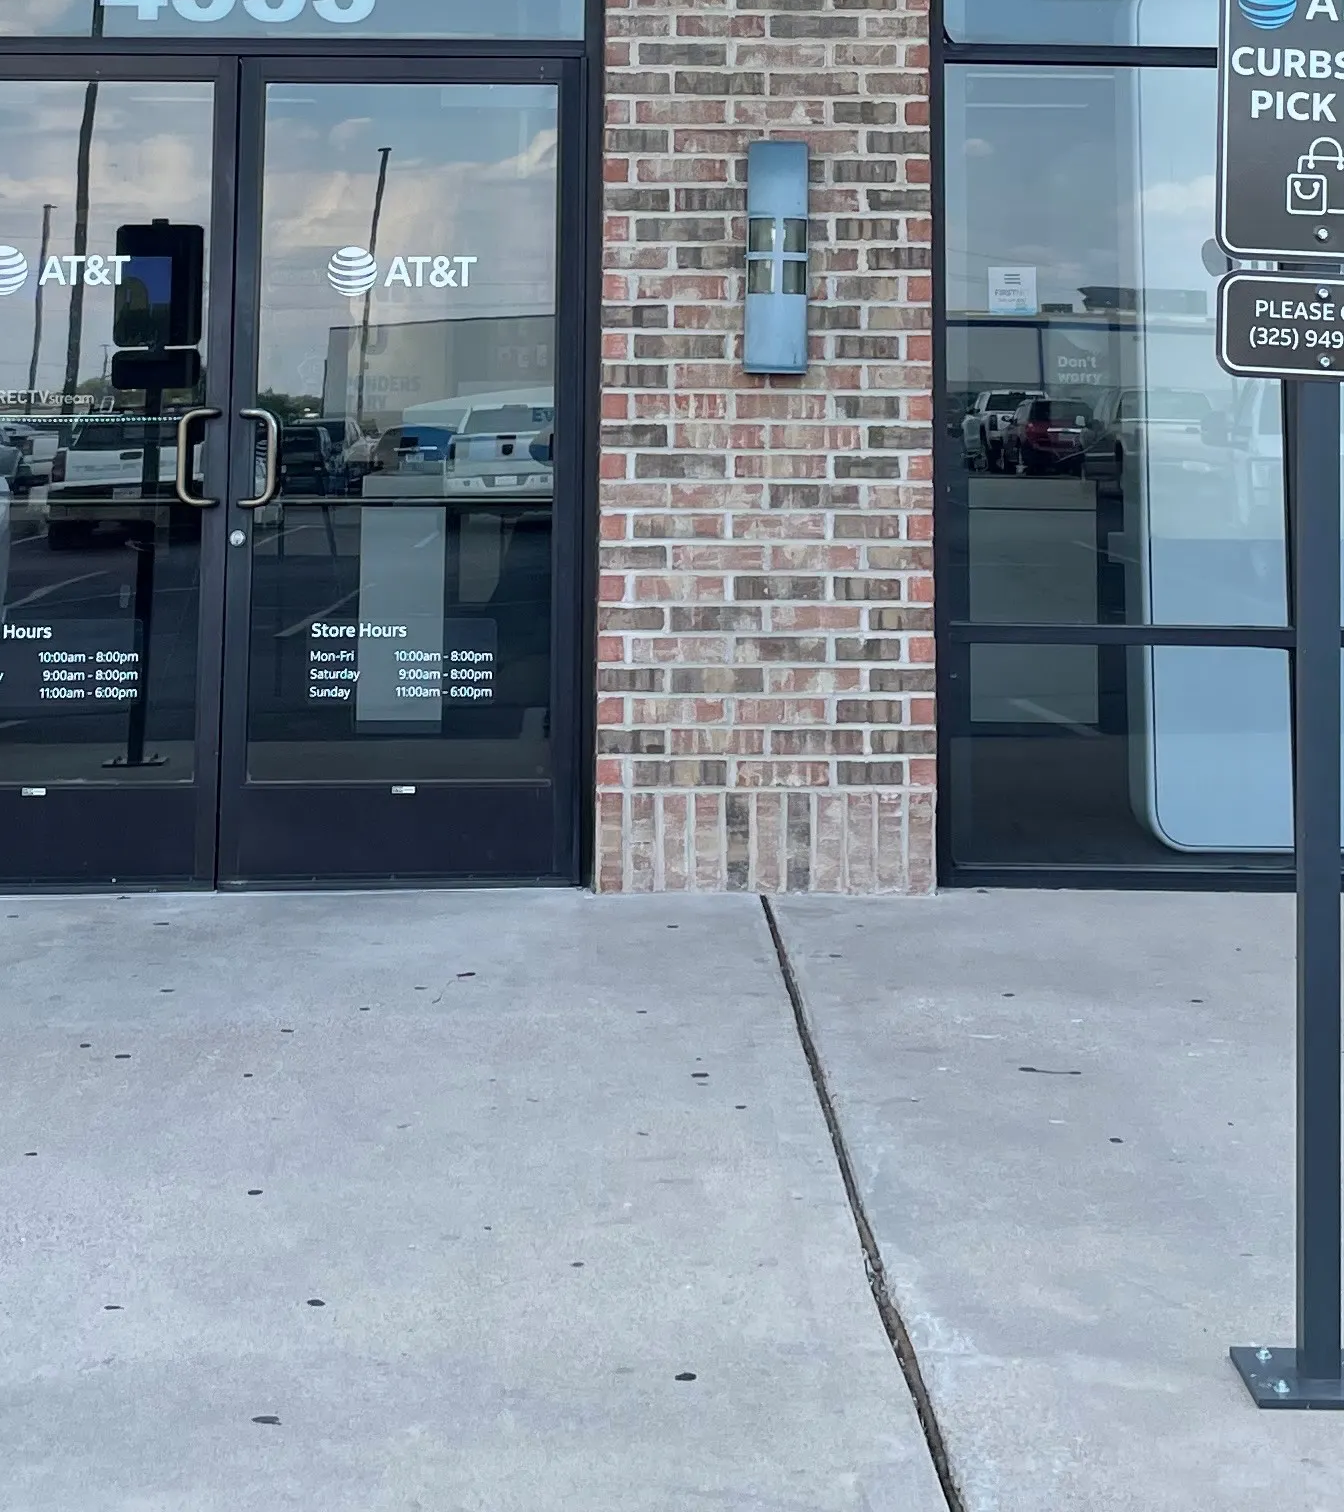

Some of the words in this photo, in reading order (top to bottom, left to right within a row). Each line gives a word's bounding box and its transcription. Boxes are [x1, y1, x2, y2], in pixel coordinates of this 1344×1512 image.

[1250, 90, 1336, 122] PICK
[40, 255, 131, 286] AT&T
[384, 255, 478, 288] AT&T
[1255, 299, 1335, 322] PLEASE
[1249, 326, 1299, 350] (325)
[1057, 356, 1097, 368] Don't
[3, 625, 52, 639] Hours
[311, 623, 356, 638] Store
[359, 623, 407, 638] Hours
[38, 652, 86, 663] 10:00am
[95, 651, 139, 665] 8:00pm
[310, 651, 354, 662] Mon-Fri
[394, 650, 441, 662] 10:00am
[451, 650, 493, 664] 8:00pm
[43, 670, 85, 681] 9:00am
[95, 669, 138, 683] 8:00pm
[310, 668, 360, 682] Saturday
[399, 669, 440, 680] 9:00am
[451, 668, 493, 683] 8:00pm
[39, 688, 84, 699] 11:00am
[95, 687, 138, 700] 6:00pm
[309, 686, 350, 700] Sunday
[395, 686, 440, 698] 11:00am
[450, 686, 492, 700] 6:00pm
